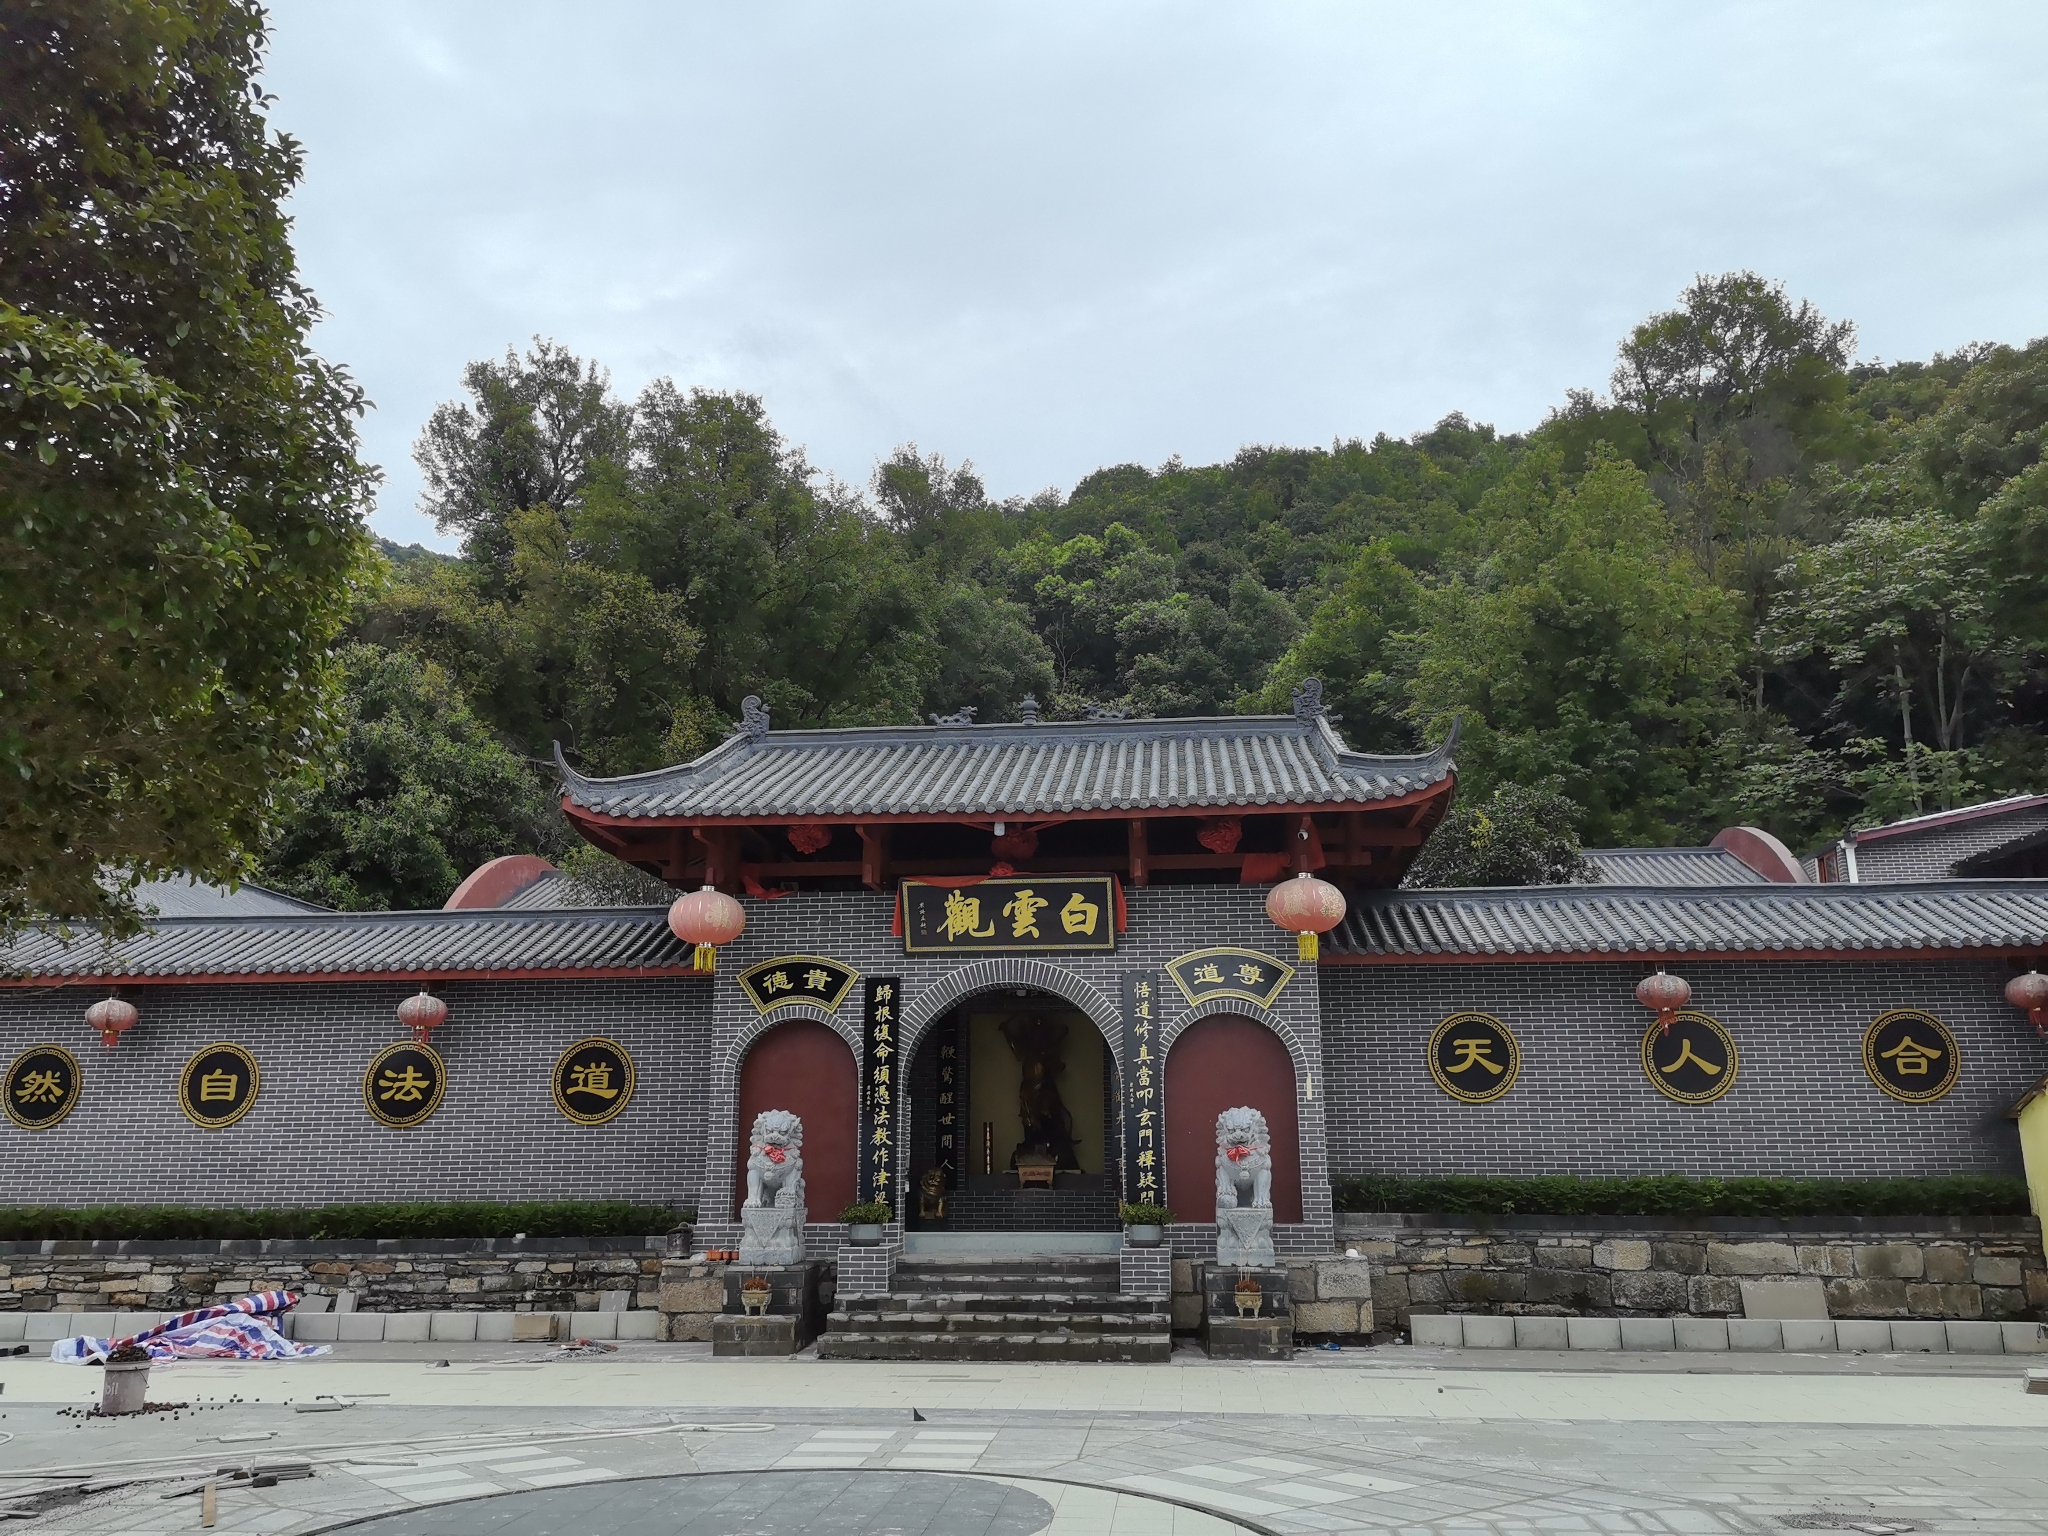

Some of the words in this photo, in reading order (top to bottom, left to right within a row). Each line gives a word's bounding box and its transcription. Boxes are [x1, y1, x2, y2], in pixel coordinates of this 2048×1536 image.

[937, 889, 1099, 942] 白雲觀
[1193, 963, 1265, 985] 尊道
[1445, 1039, 1504, 1075] 天
[1661, 1039, 1721, 1075] 人
[1880, 1036, 1942, 1075] 合
[15, 1069, 64, 1104] 然
[200, 1068, 237, 1102] 自
[378, 1065, 429, 1102] 法
[566, 1062, 618, 1098] 道
